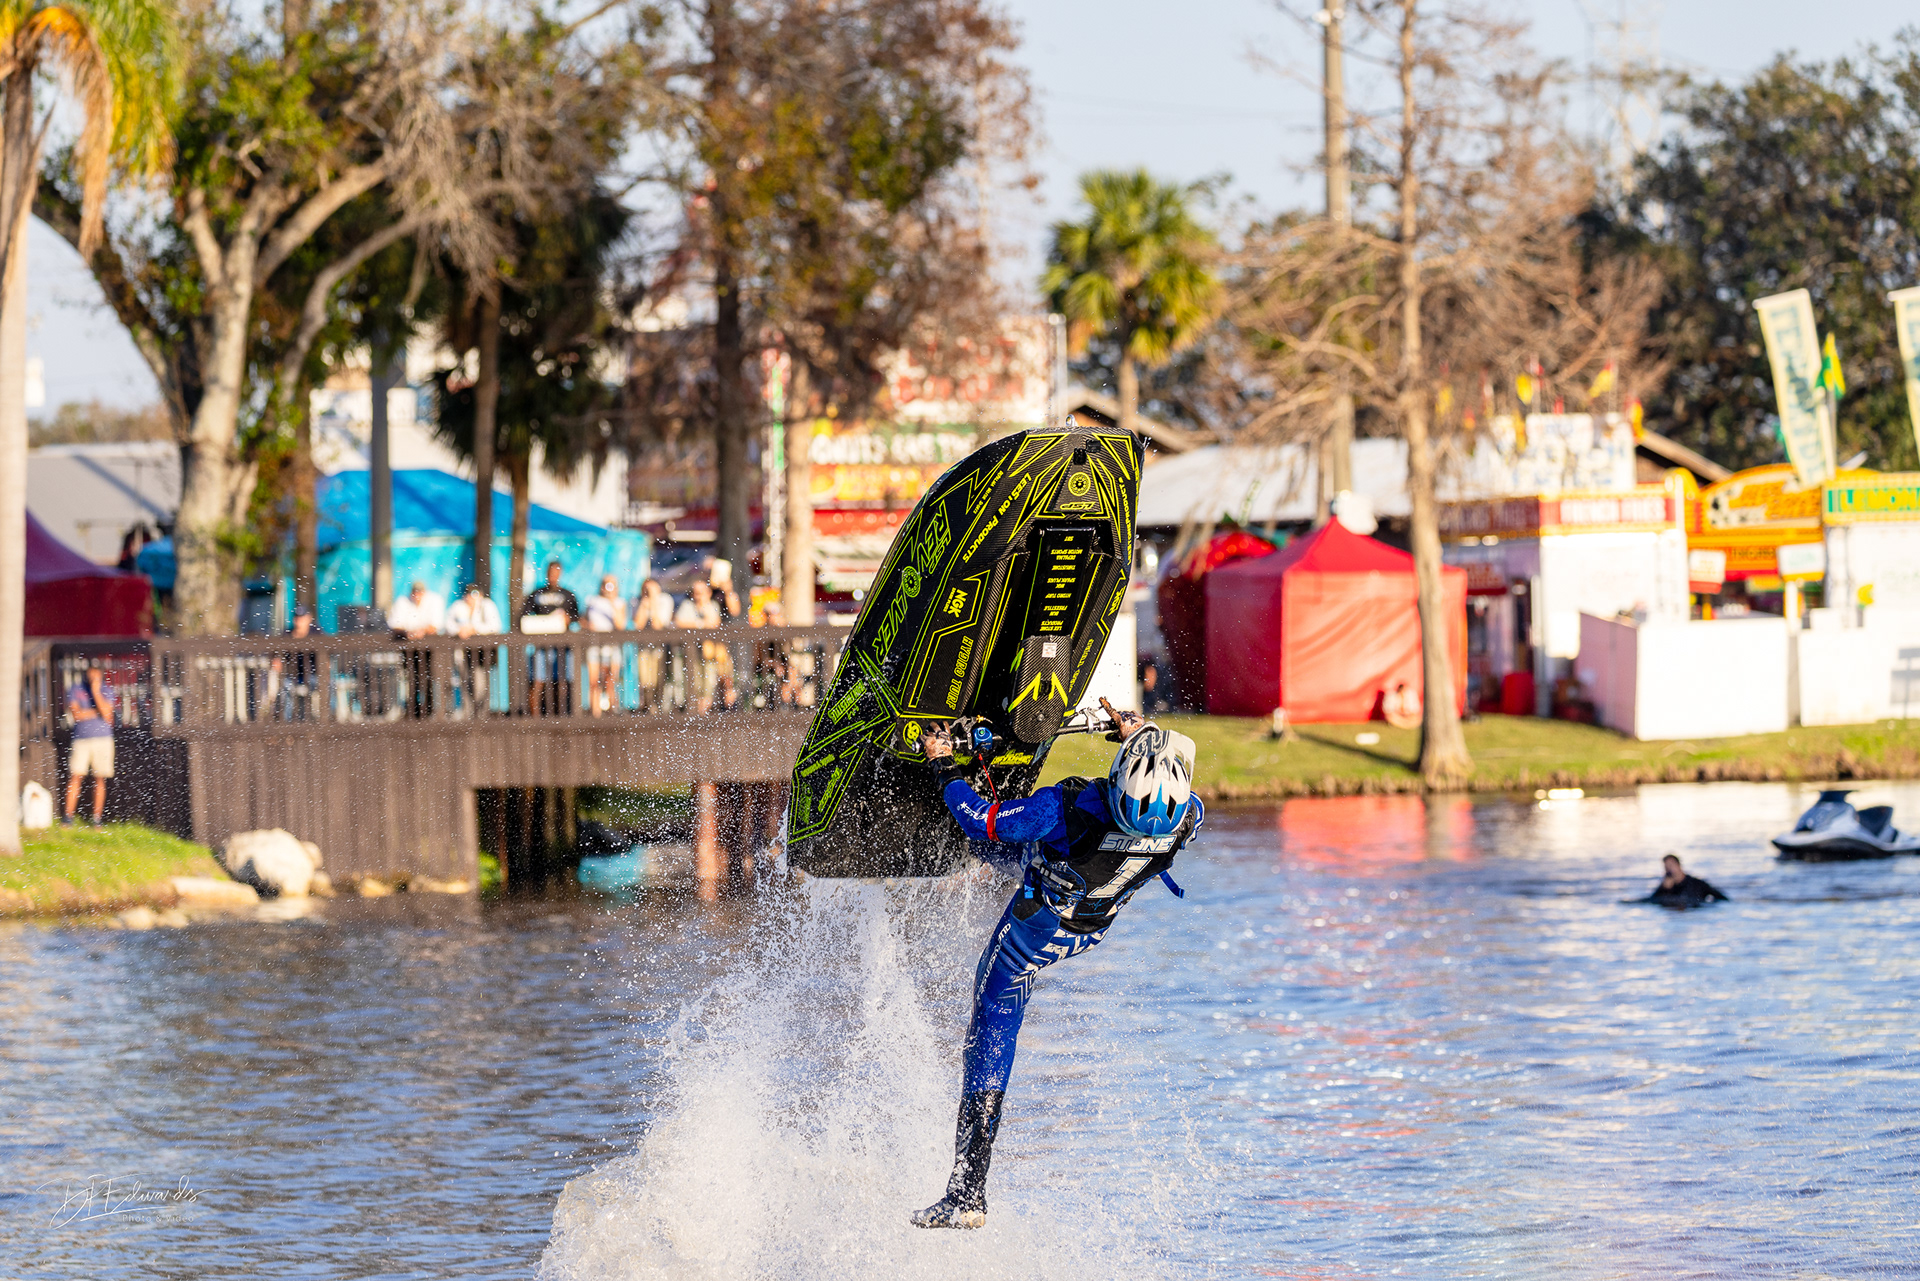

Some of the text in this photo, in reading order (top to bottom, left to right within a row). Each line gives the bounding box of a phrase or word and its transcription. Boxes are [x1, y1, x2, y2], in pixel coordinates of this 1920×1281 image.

[1060, 502, 1096, 510] LSP
[1839, 489, 1920, 512] LEMON
[962, 514, 999, 563] PRODUCTS
[948, 588, 968, 618] NGK
[946, 636, 974, 710] HYDRO TURF
[1098, 831, 1178, 854] STONE
[1086, 856, 1153, 898] 1
